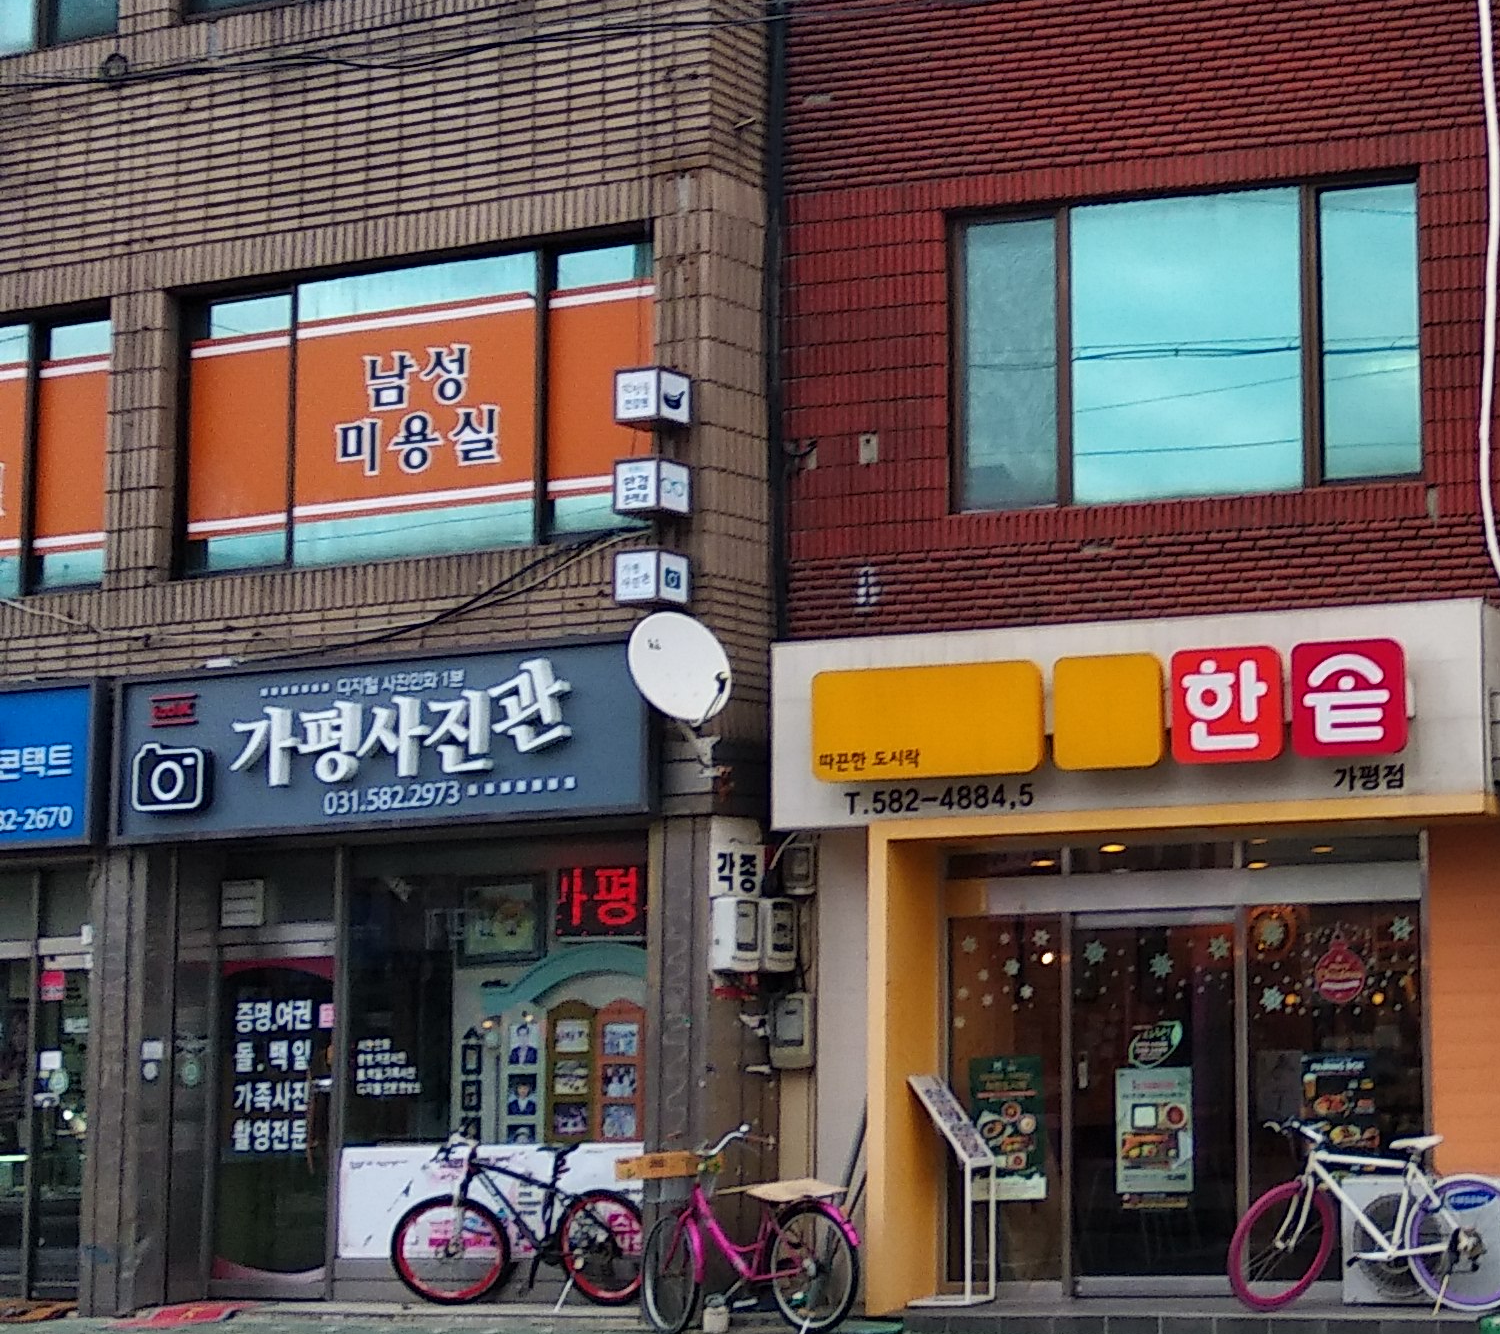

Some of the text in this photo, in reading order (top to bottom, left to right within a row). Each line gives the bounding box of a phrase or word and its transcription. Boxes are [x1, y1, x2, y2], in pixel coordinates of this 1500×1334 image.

[363, 344, 471, 411] 남성
[335, 404, 501, 476] 미용실
[336, 676, 379, 696] 디지털
[229, 658, 572, 788] 가평사진관
[872, 747, 921, 769] 도시락
[1333, 764, 1405, 791] 가평점
[322, 781, 462, 816] 031.582.2973
[845, 783, 1034, 816] T.582-4884,5
[717, 852, 757, 894] 각종
[235, 999, 313, 1034] 증명.여권
[234, 1080, 309, 1113] 가족사진
[232, 1118, 308, 1152] 촬영전문
